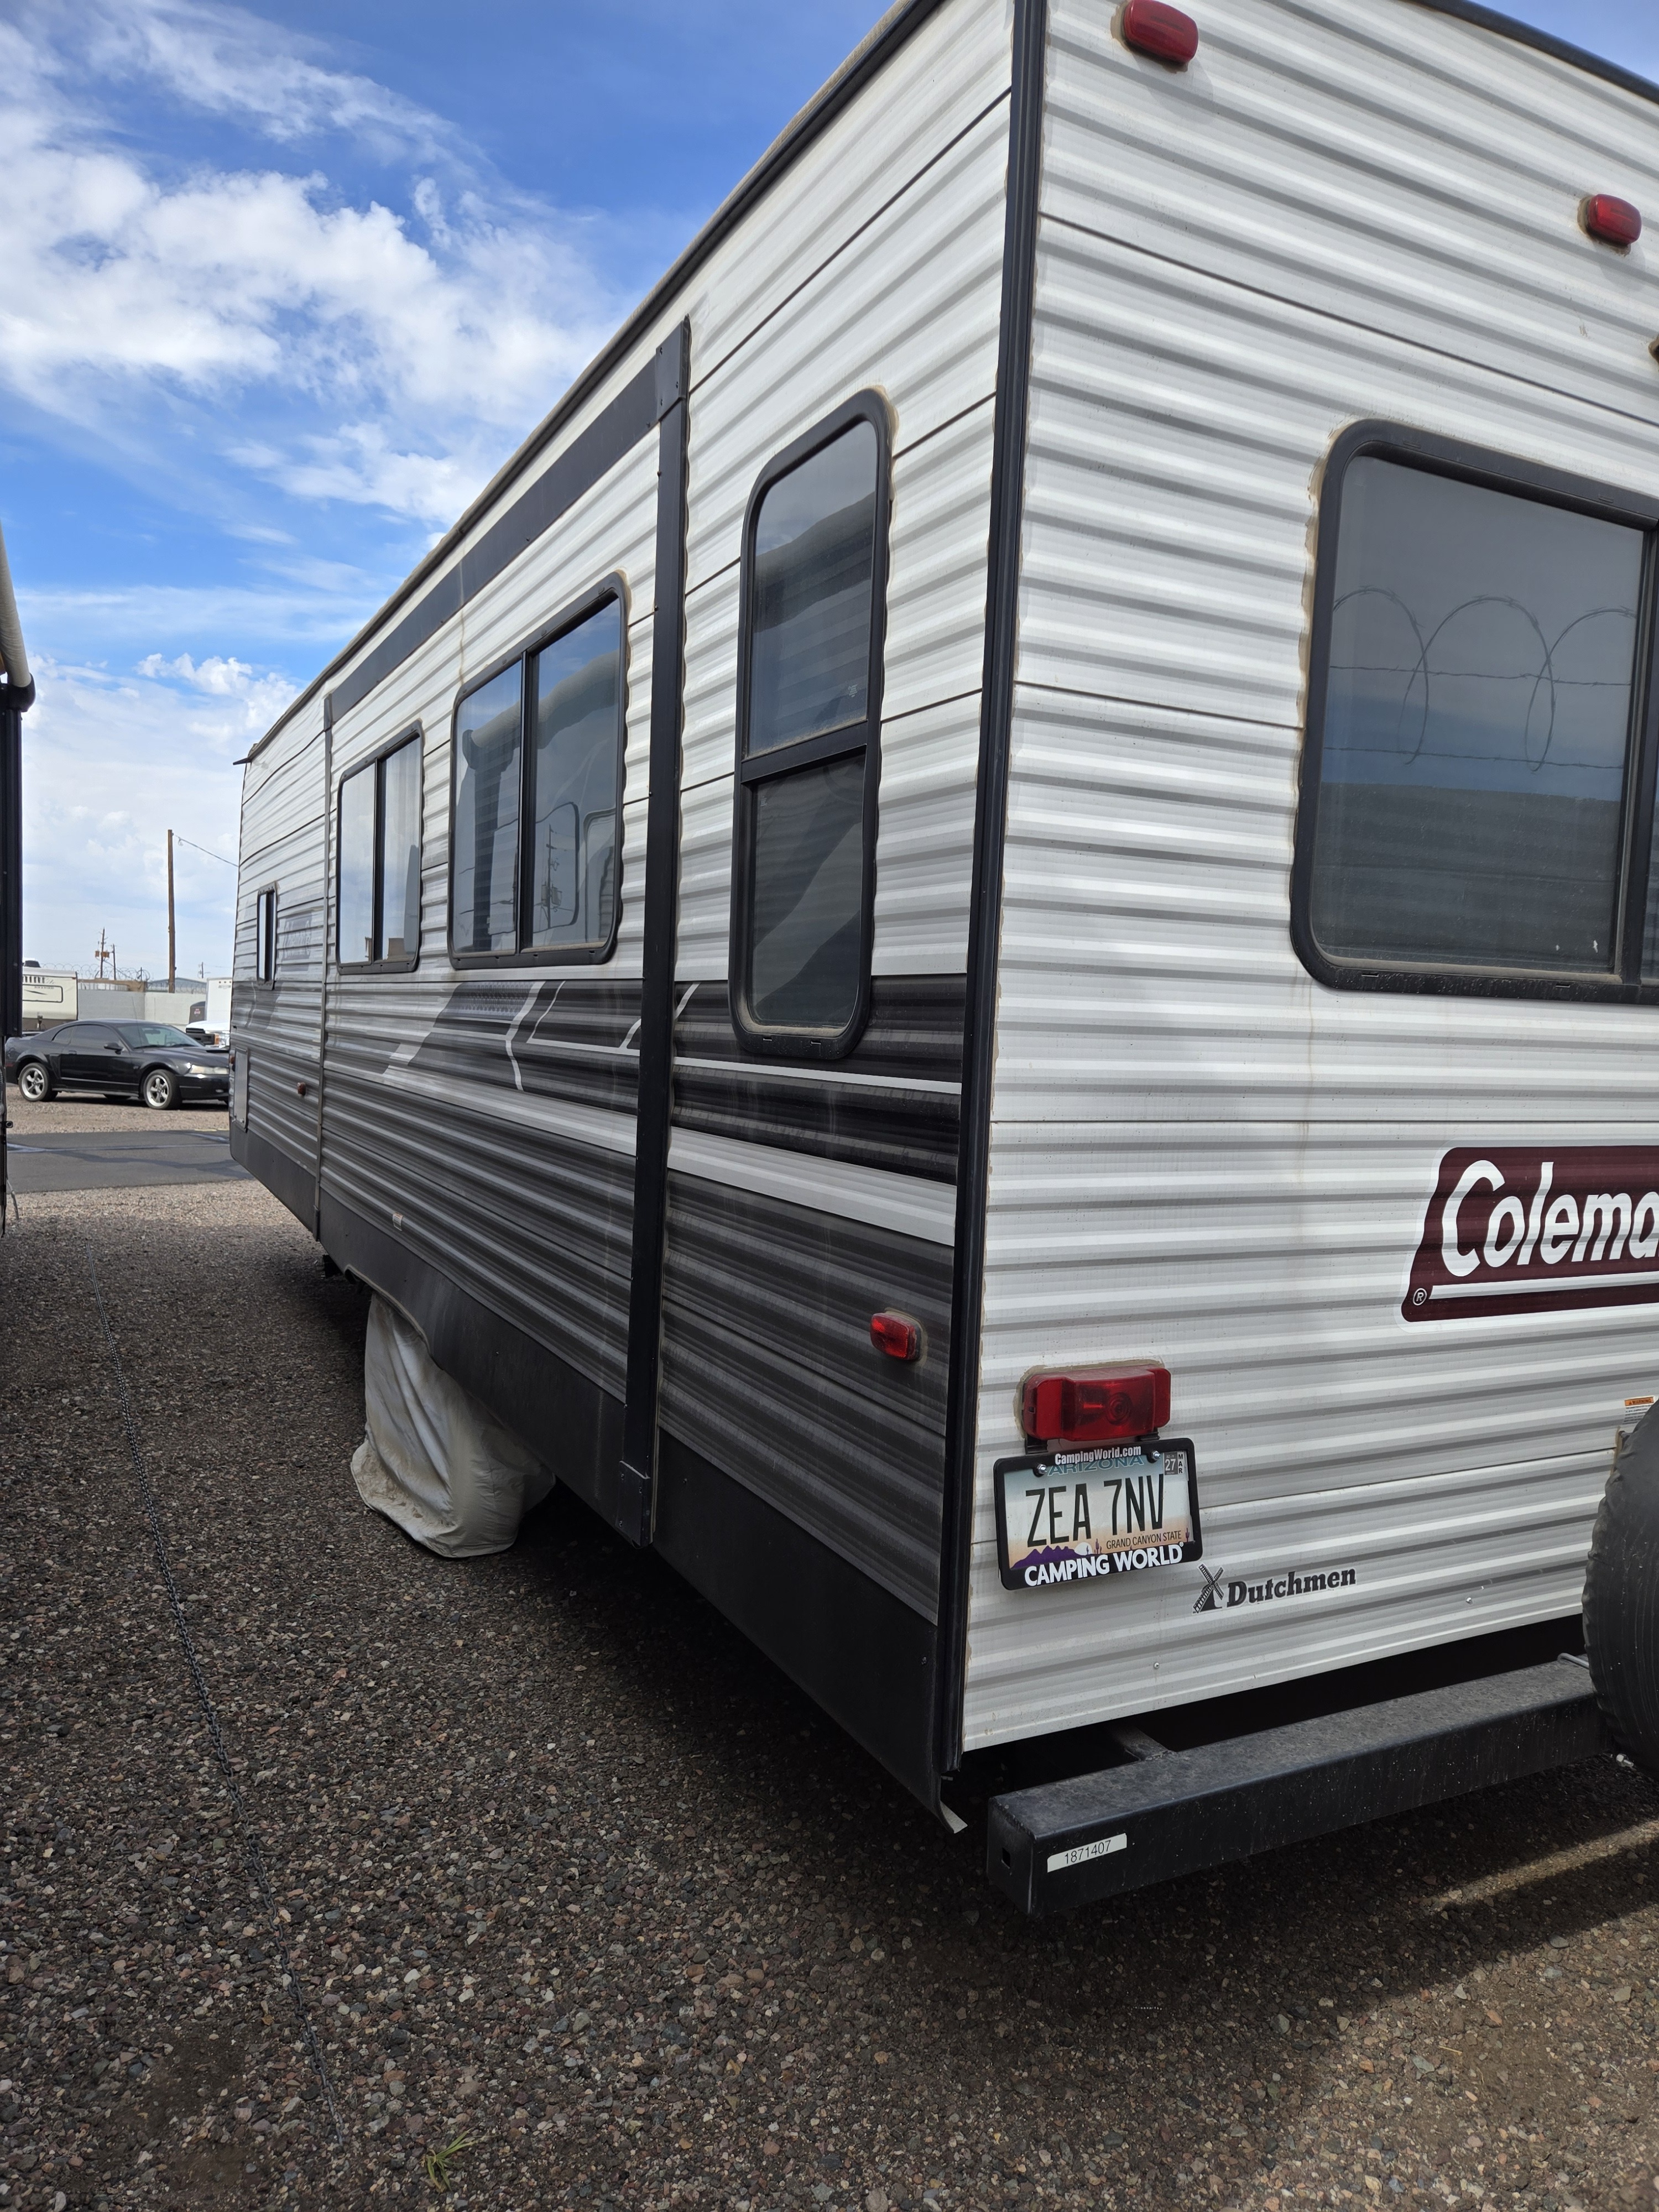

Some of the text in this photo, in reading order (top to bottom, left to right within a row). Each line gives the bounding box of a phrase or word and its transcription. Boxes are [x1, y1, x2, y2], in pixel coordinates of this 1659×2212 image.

[1047, 1455, 1144, 1476] ARIZONA
[1055, 1446, 1141, 1465] CampingWorld.com
[1165, 1458, 1176, 1471] 27
[1025, 1474, 1164, 1547] ZEA 7NV
[1107, 1530, 1182, 1550] GRAND CANYON STATE
[1025, 1543, 1182, 1587] CAMPING WORLD
[1227, 1568, 1356, 1608] Dutchmen
[1065, 1840, 1111, 1864] 1871407
